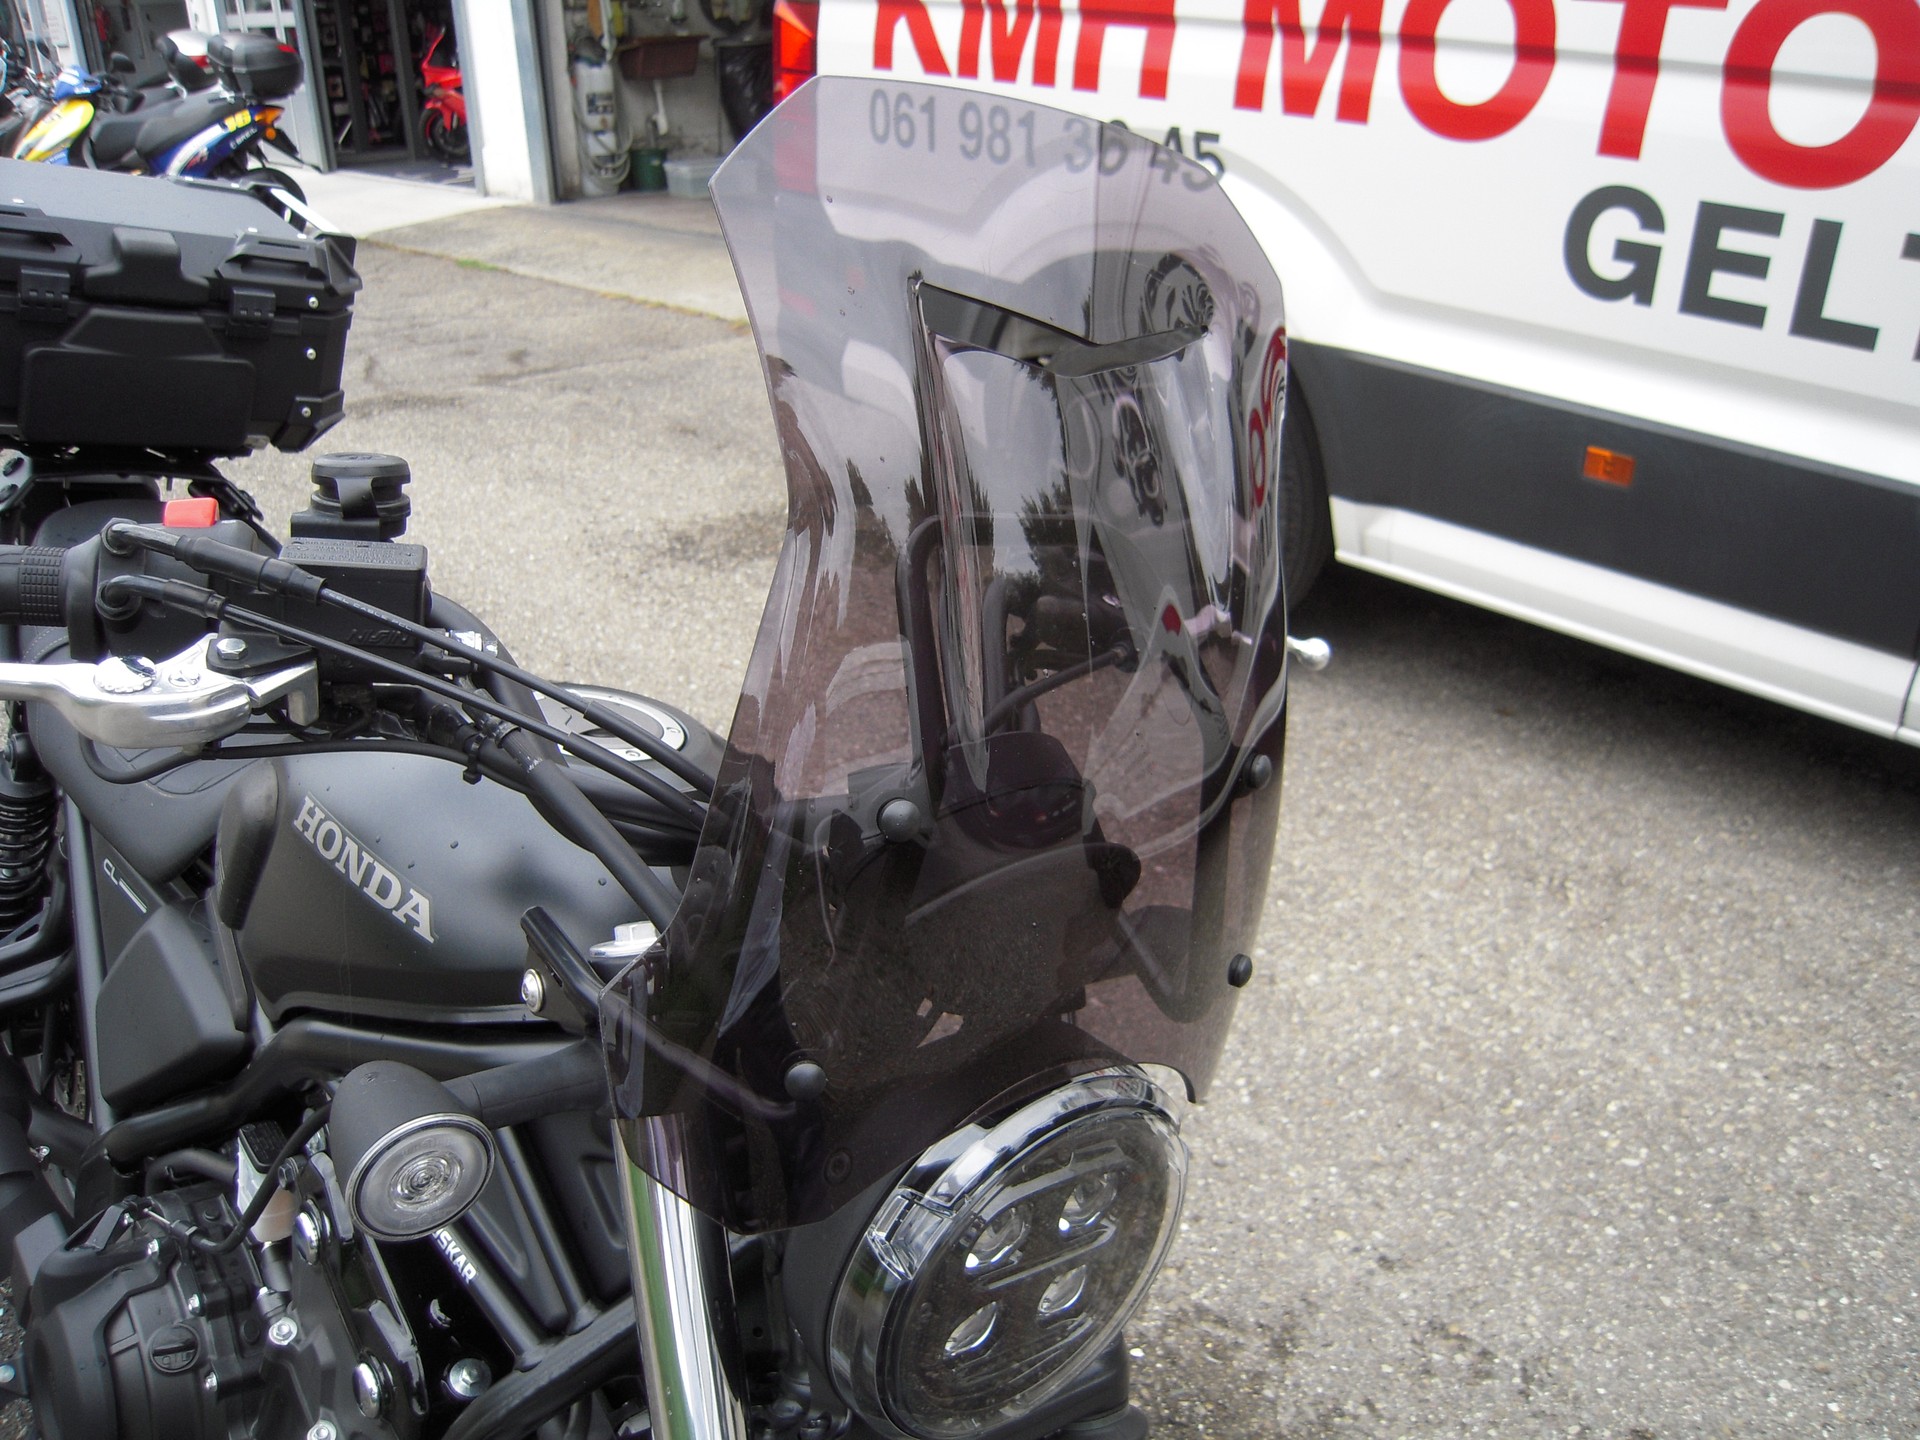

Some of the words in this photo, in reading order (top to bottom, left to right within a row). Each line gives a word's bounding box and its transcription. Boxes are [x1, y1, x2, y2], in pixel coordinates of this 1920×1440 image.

[869, 88, 936, 153] 061
[959, 101, 1036, 168] 981
[1149, 126, 1225, 193] 45
[1233, 0, 1920, 191] MOTO
[294, 795, 435, 944] HONDA
